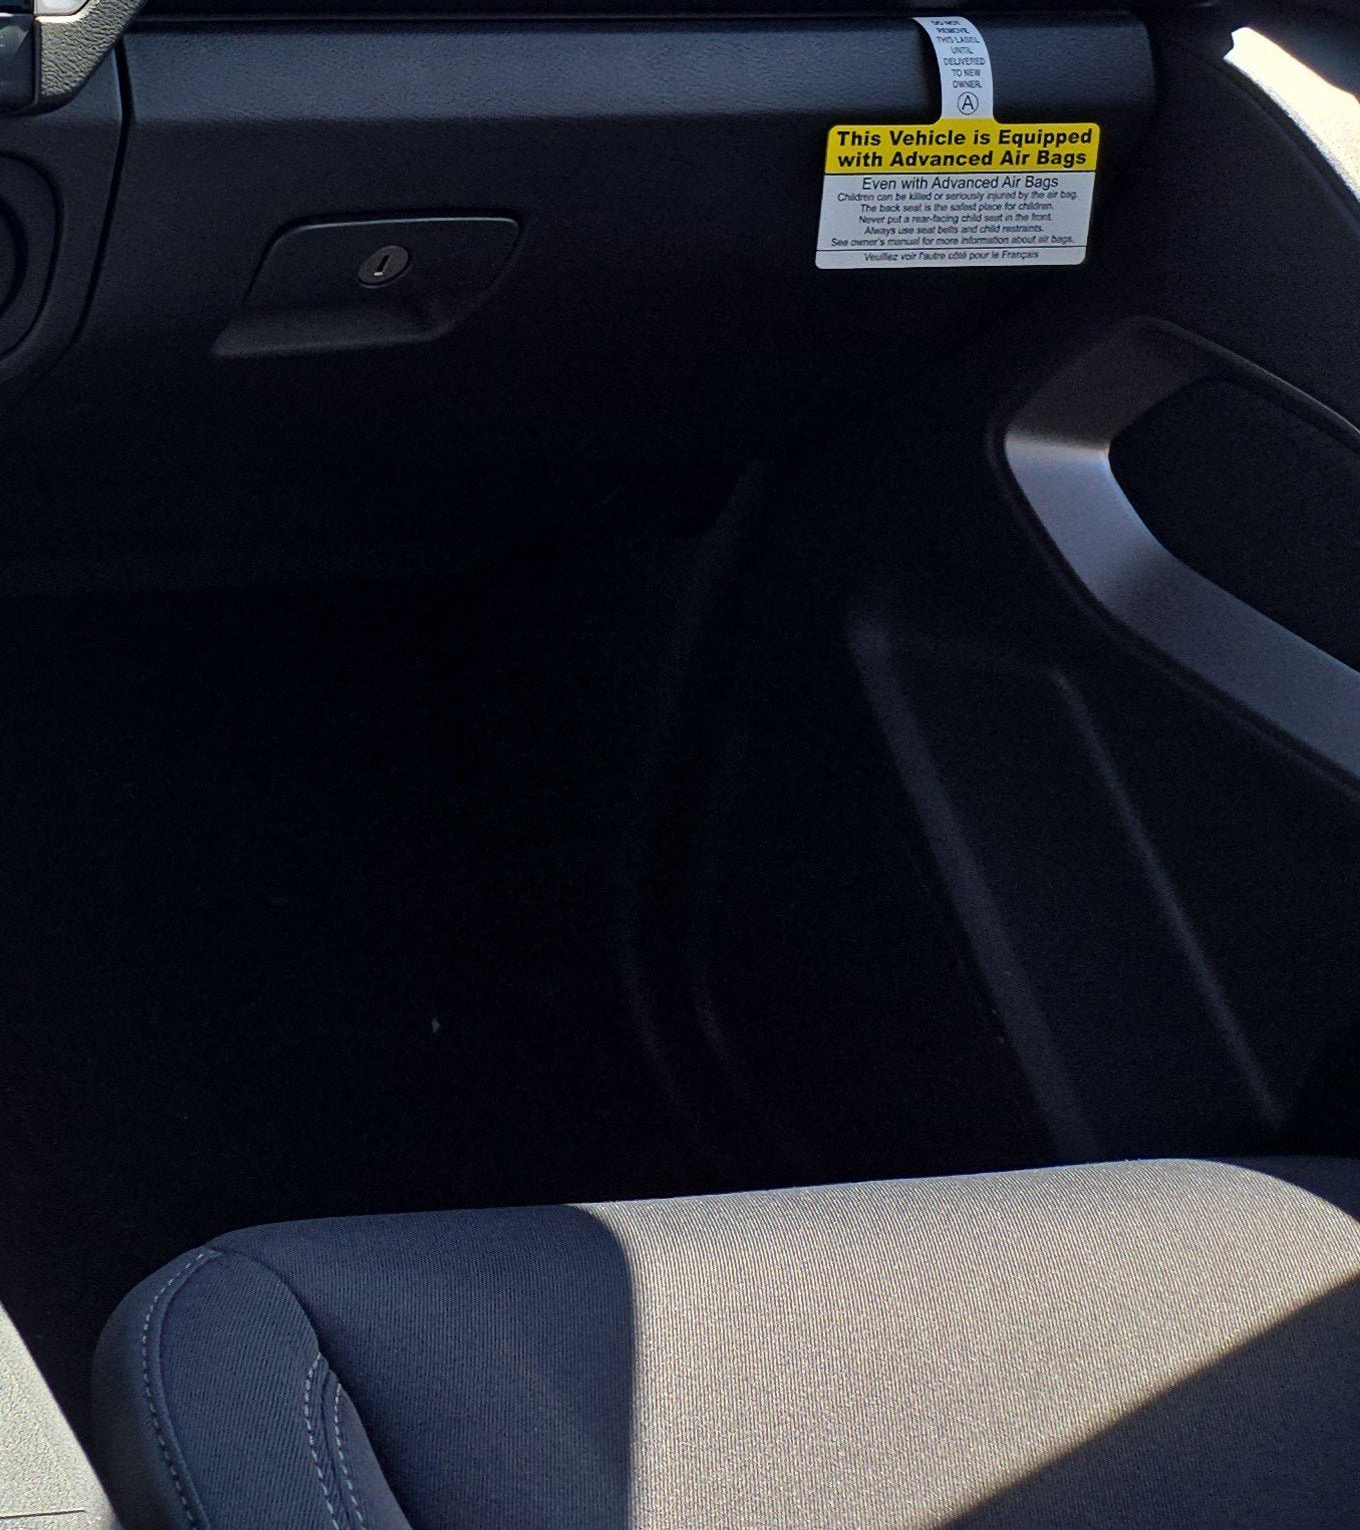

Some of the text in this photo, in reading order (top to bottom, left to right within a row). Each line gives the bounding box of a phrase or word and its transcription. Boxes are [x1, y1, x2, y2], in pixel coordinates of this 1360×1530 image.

[943, 57, 986, 65] DELIVERED
[951, 69, 981, 77] TO NEW
[961, 94, 974, 110] A
[837, 128, 1092, 148] This Vehicle is Equipped
[838, 149, 1086, 169] with Advanced Air Bags
[862, 175, 1059, 191] Even with Advanced Air Bags
[838, 192, 874, 201] Children
[895, 193, 906, 201] be
[909, 192, 932, 201] killed
[946, 192, 984, 202] seriously
[986, 191, 1016, 201] injured
[1018, 191, 1029, 201] by
[1031, 191, 1045, 200] the
[1047, 191, 1058, 199] air
[860, 203, 877, 212] The
[879, 203, 900, 212] back
[903, 203, 922, 212] seat
[934, 203, 948, 211] the
[950, 202, 976, 211] safest
[979, 202, 1002, 212] place
[1004, 201, 1017, 210] for
[1018, 201, 1053, 210] children.
[859, 215, 885, 224] Never
[887, 215, 902, 224] put
[912, 214, 959, 224] rear-facing
[961, 213, 982, 222] child
[984, 214, 1003, 222] seat
[1005, 214, 1013, 222] in
[1015, 213, 1029, 222] the
[864, 227, 895, 236] Always
[917, 226, 936, 234] seat
[937, 226, 959, 234] belts
[960, 226, 978, 234] and
[980, 225, 1000, 233] child
[831, 238, 848, 247] See
[850, 238, 885, 246] owner's
[887, 237, 920, 246] manual
[922, 236, 933, 245] for
[961, 235, 1009, 244] information
[1011, 235, 1036, 244] about
[1038, 235, 1050, 243] air
[864, 252, 897, 261] Veuillez
[901, 252, 916, 260] voir
[948, 251, 967, 260] côté
[992, 251, 1000, 259] le
[1002, 250, 1039, 260] Français
